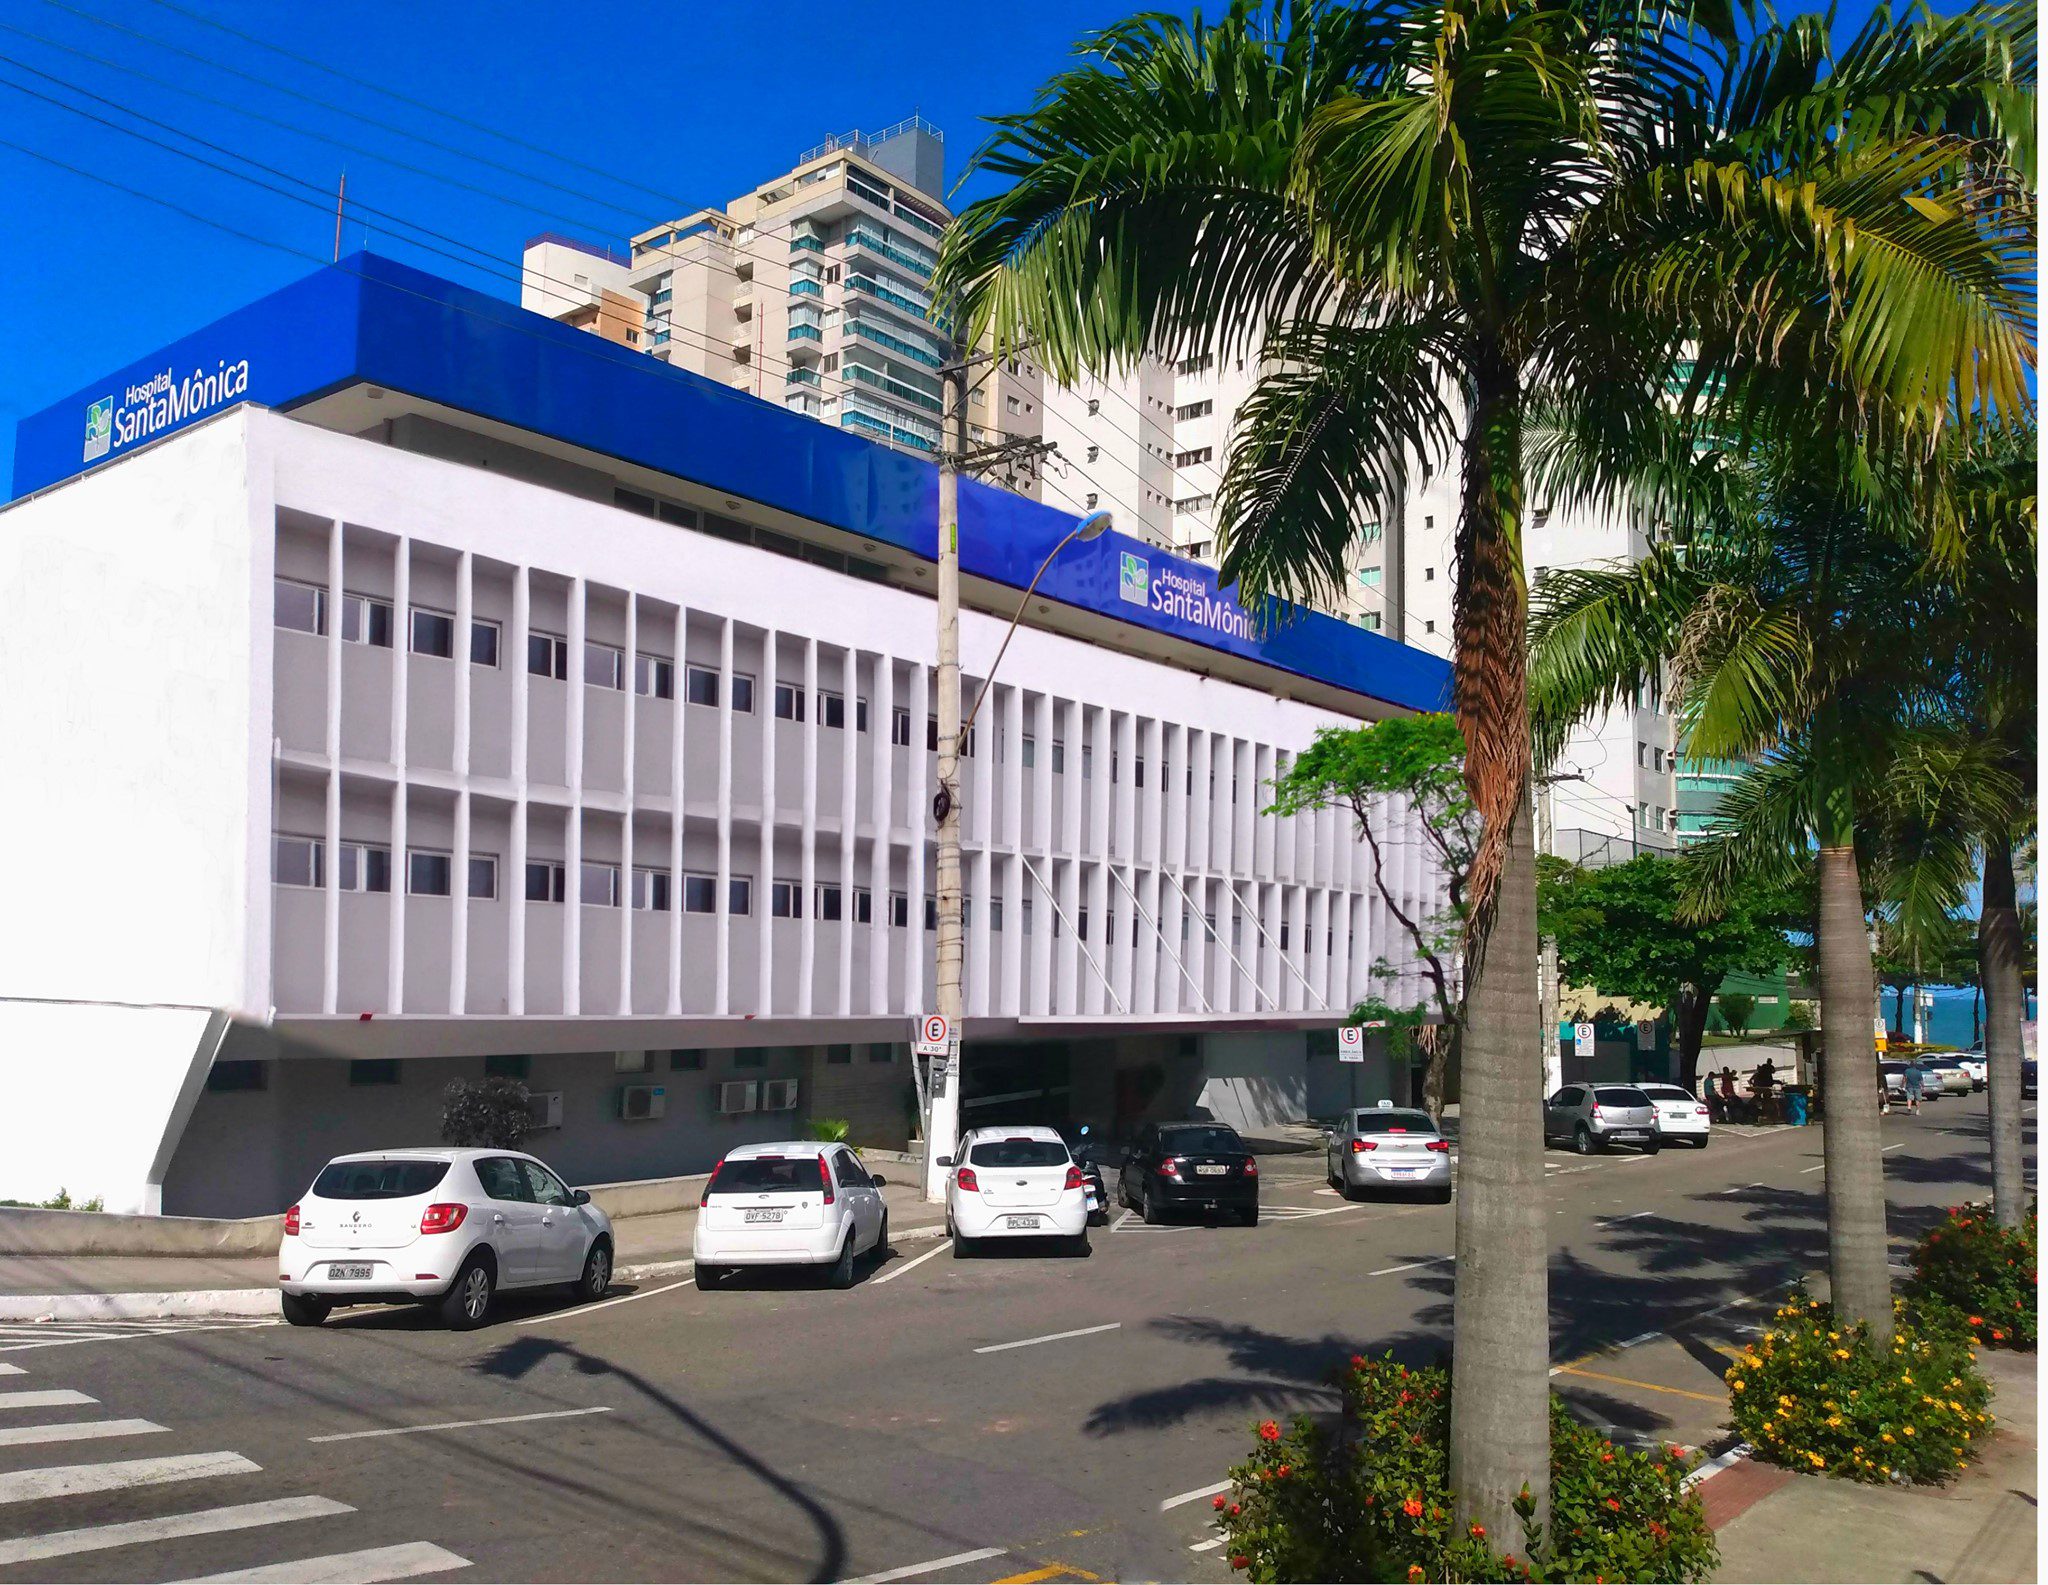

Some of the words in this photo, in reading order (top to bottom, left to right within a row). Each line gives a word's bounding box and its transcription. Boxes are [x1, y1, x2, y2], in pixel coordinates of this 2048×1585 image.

[126, 367, 172, 406] Hospital
[113, 359, 249, 448] SantaMônica
[1162, 568, 1206, 598] Hospital
[1151, 579, 1257, 642] SantaMônic
[931, 1023, 939, 1037] E
[1347, 1029, 1354, 1041] E
[1581, 1027, 1587, 1036] E
[1643, 1023, 1649, 1032] E
